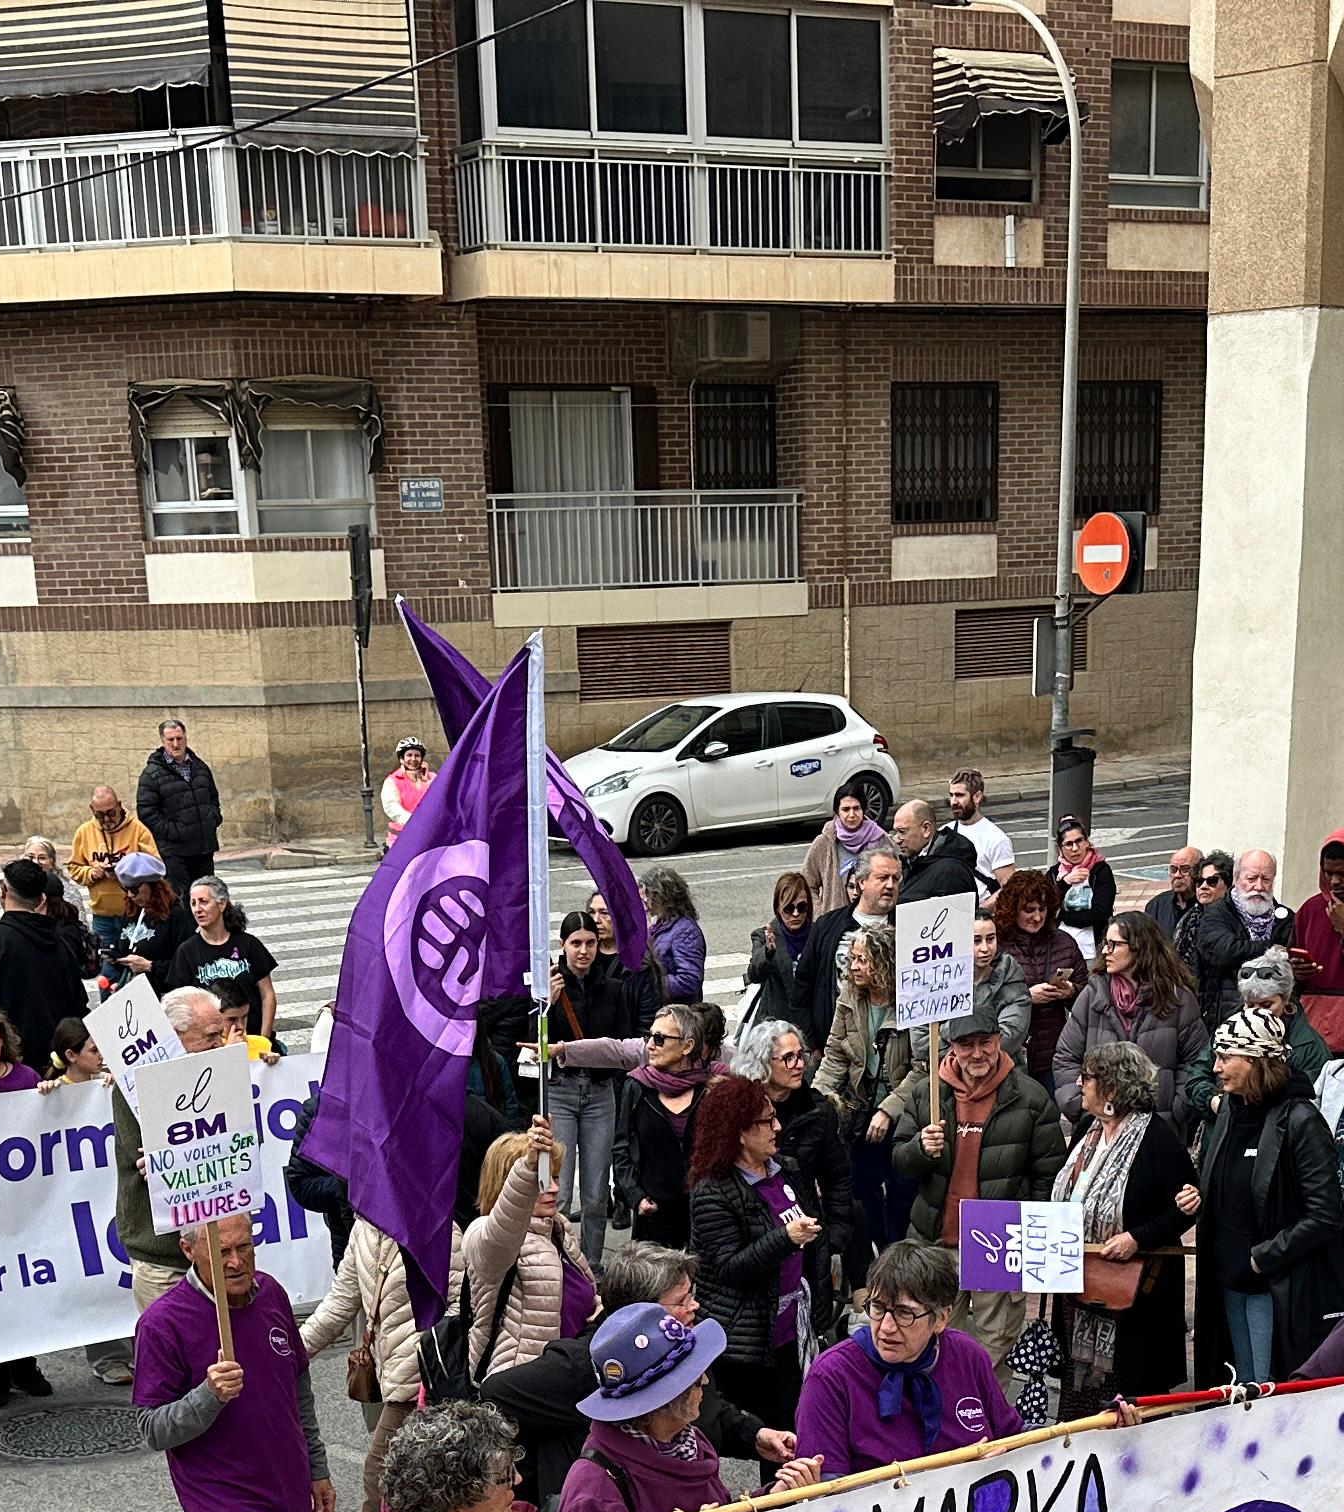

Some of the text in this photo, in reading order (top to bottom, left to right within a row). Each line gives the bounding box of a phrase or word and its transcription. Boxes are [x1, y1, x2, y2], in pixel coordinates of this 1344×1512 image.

[920, 907, 949, 942] el
[912, 941, 954, 964] 8M
[901, 963, 966, 989] FALTAN
[929, 981, 949, 993] LAS
[117, 999, 139, 1040] el
[897, 992, 972, 1023] ASESINADAS
[120, 1028, 159, 1067] 8M
[174, 1066, 213, 1114] el
[166, 1112, 228, 1146] 8M
[149, 1148, 175, 1174] NO
[184, 1143, 222, 1163] VOLEM
[161, 1152, 253, 1190] VALENTES
[164, 1180, 234, 1206] VOLEM SER
[170, 1188, 252, 1229] LLIURES
[970, 1229, 1003, 1264] el
[1004, 1223, 1023, 1274] 8M
[1025, 1213, 1048, 1284] ALCEM
[1059, 1230, 1080, 1276] VEU
[19, 1252, 57, 1288] la
